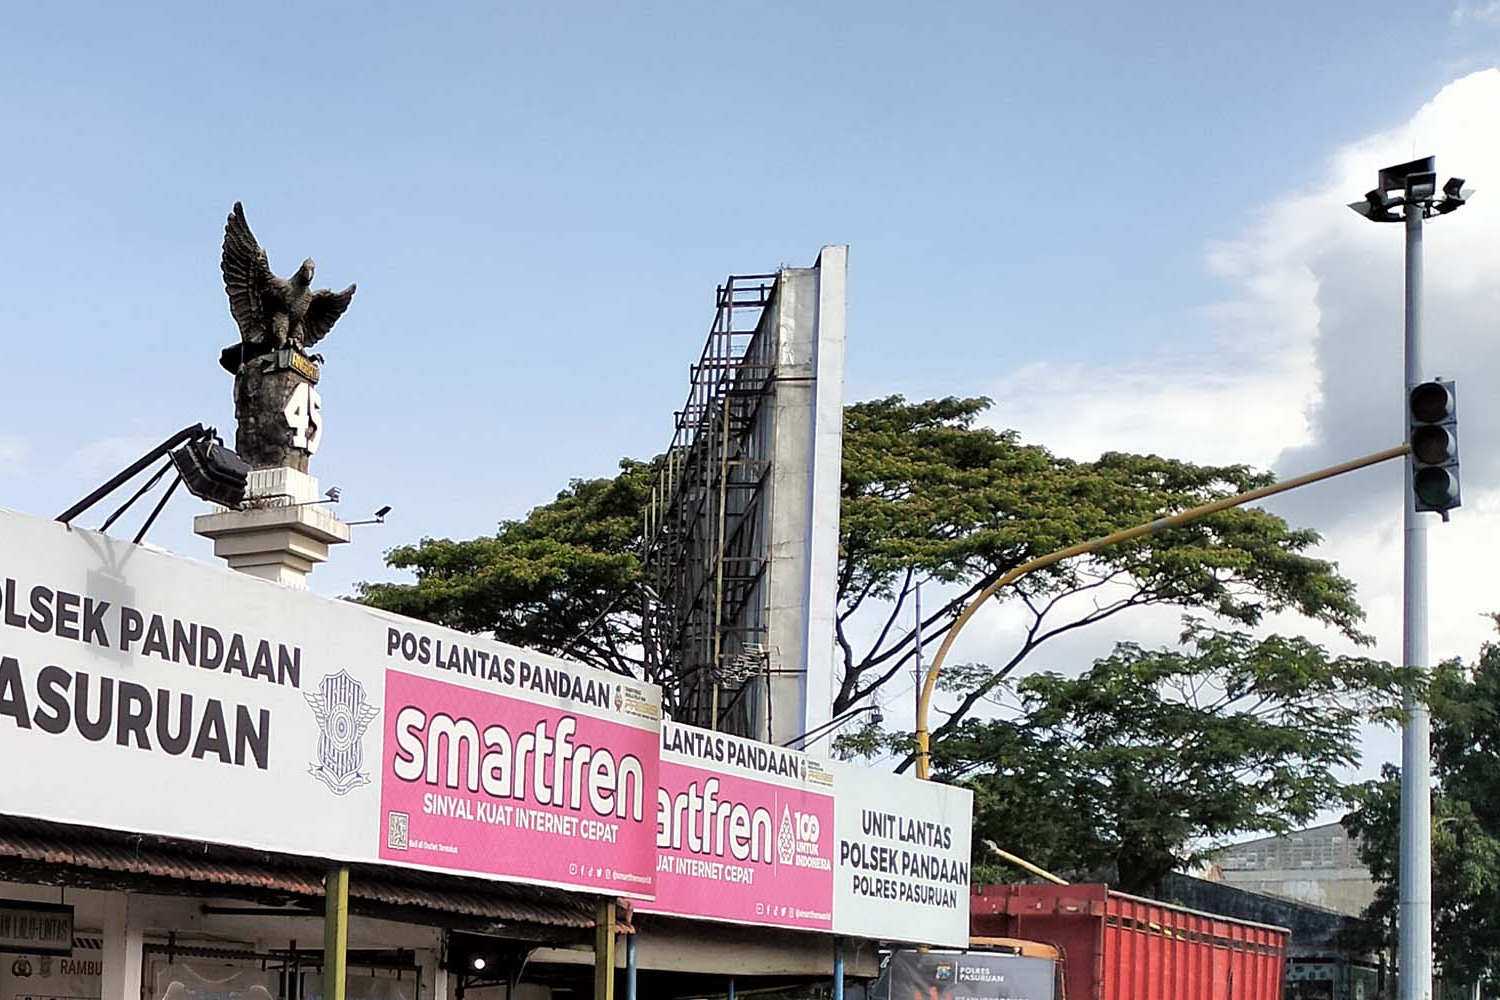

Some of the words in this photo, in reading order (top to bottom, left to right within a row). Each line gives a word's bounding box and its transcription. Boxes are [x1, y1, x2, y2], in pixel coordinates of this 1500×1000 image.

[284, 382, 323, 455] 45
[120, 605, 301, 689] PANDAAN
[387, 627, 432, 664] POS
[435, 642, 516, 686] LANTAS
[519, 664, 611, 709] PANDAAN
[392, 705, 645, 823] smartfren
[662, 725, 724, 762] LANTAS
[727, 740, 799, 780] PANDAAN
[423, 792, 475, 821] SINYAL
[477, 802, 515, 827] KUAT
[515, 807, 579, 839] INTERNET
[579, 819, 619, 845] CEPAT
[862, 809, 896, 840] UNIT
[899, 816, 952, 850] LANTAS
[676, 857, 724, 881] INTERNET
[724, 865, 755, 885] CEPAT
[795, 841, 820, 856] UNTUK
[795, 854, 832, 871] INDONESIA
[840, 840, 899, 875] POLSEK
[902, 850, 968, 887] PANDAAN
[853, 874, 898, 900] POLRES
[899, 881, 957, 909] PASURUAN
